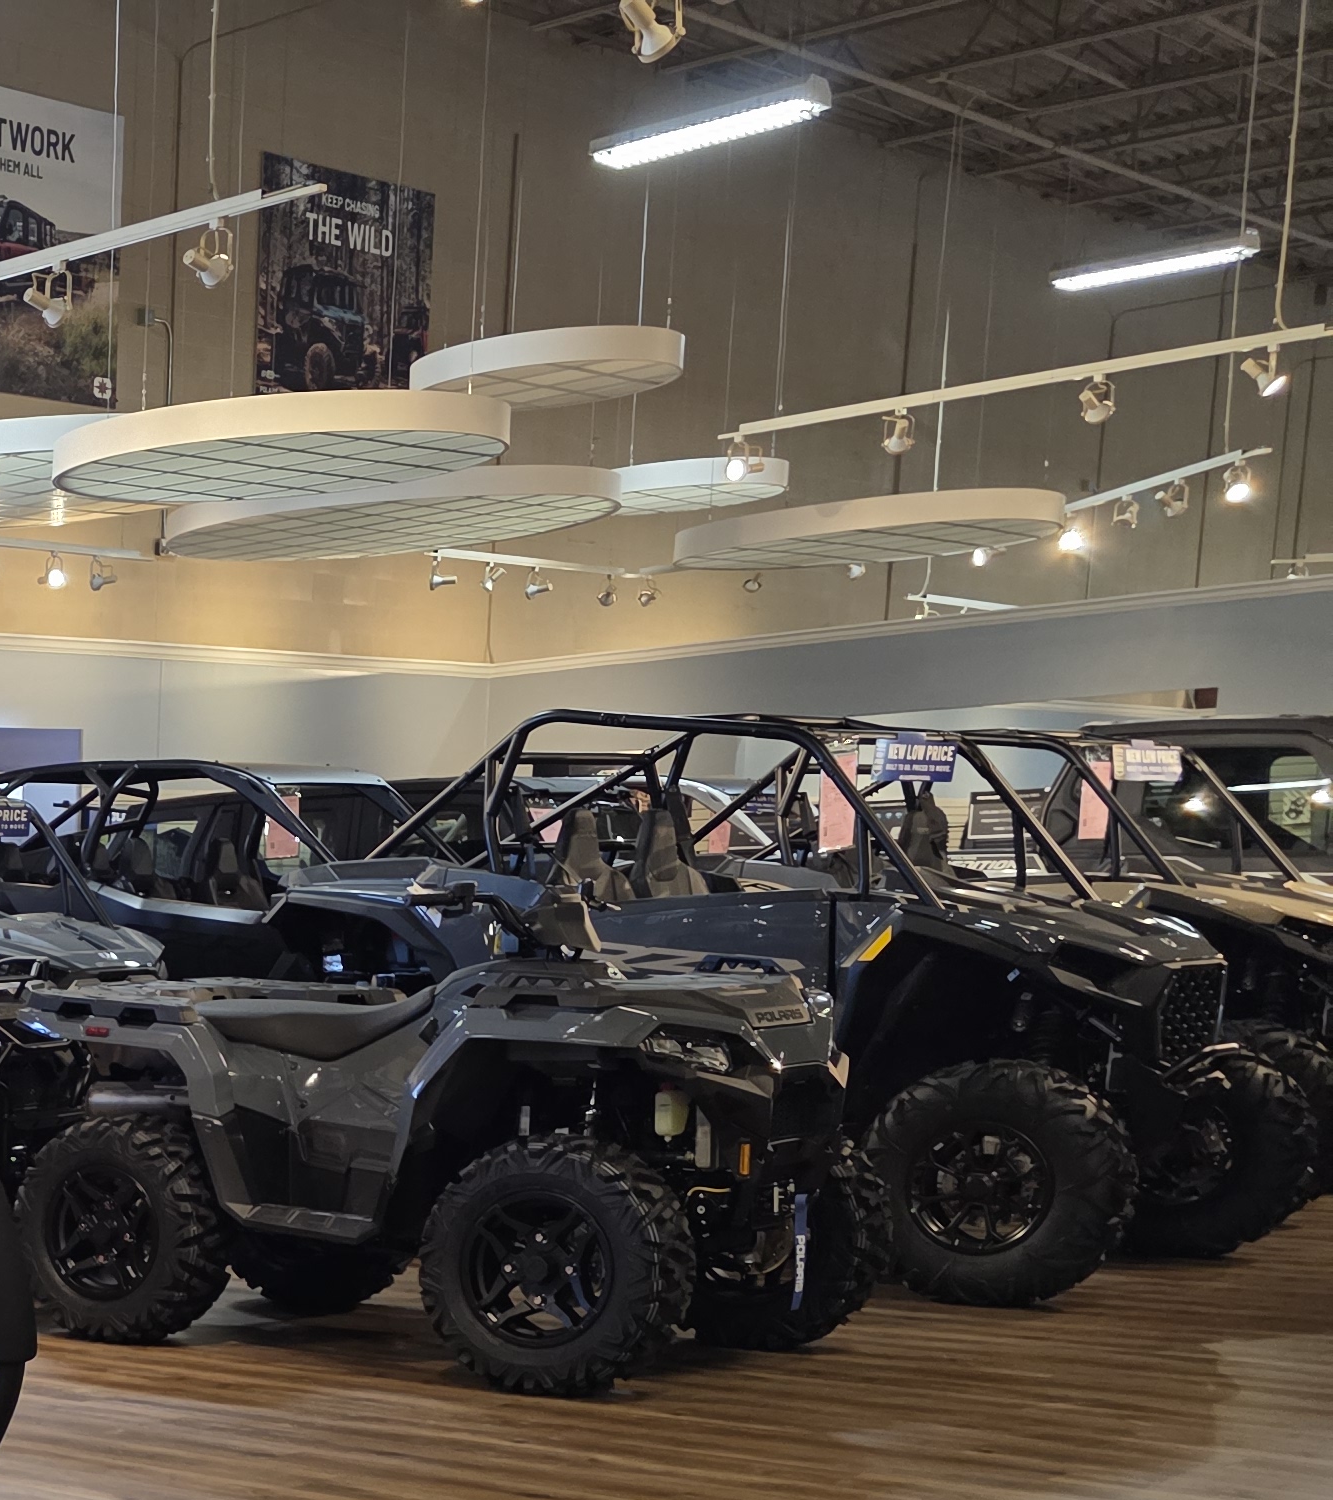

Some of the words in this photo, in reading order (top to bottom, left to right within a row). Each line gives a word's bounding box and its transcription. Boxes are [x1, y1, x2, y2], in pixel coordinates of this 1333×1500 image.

[23, 162, 43, 179] ALL
[321, 193, 343, 209] KEEP
[344, 198, 380, 219] CHASING
[305, 211, 343, 247] THE
[347, 221, 393, 257] WILD
[888, 744, 907, 759] NEW
[907, 744, 926, 760] LOW
[926, 745, 955, 761] PRICE
[755, 1008, 804, 1024] POLARIS
[794, 1234, 806, 1293] POLARIS
